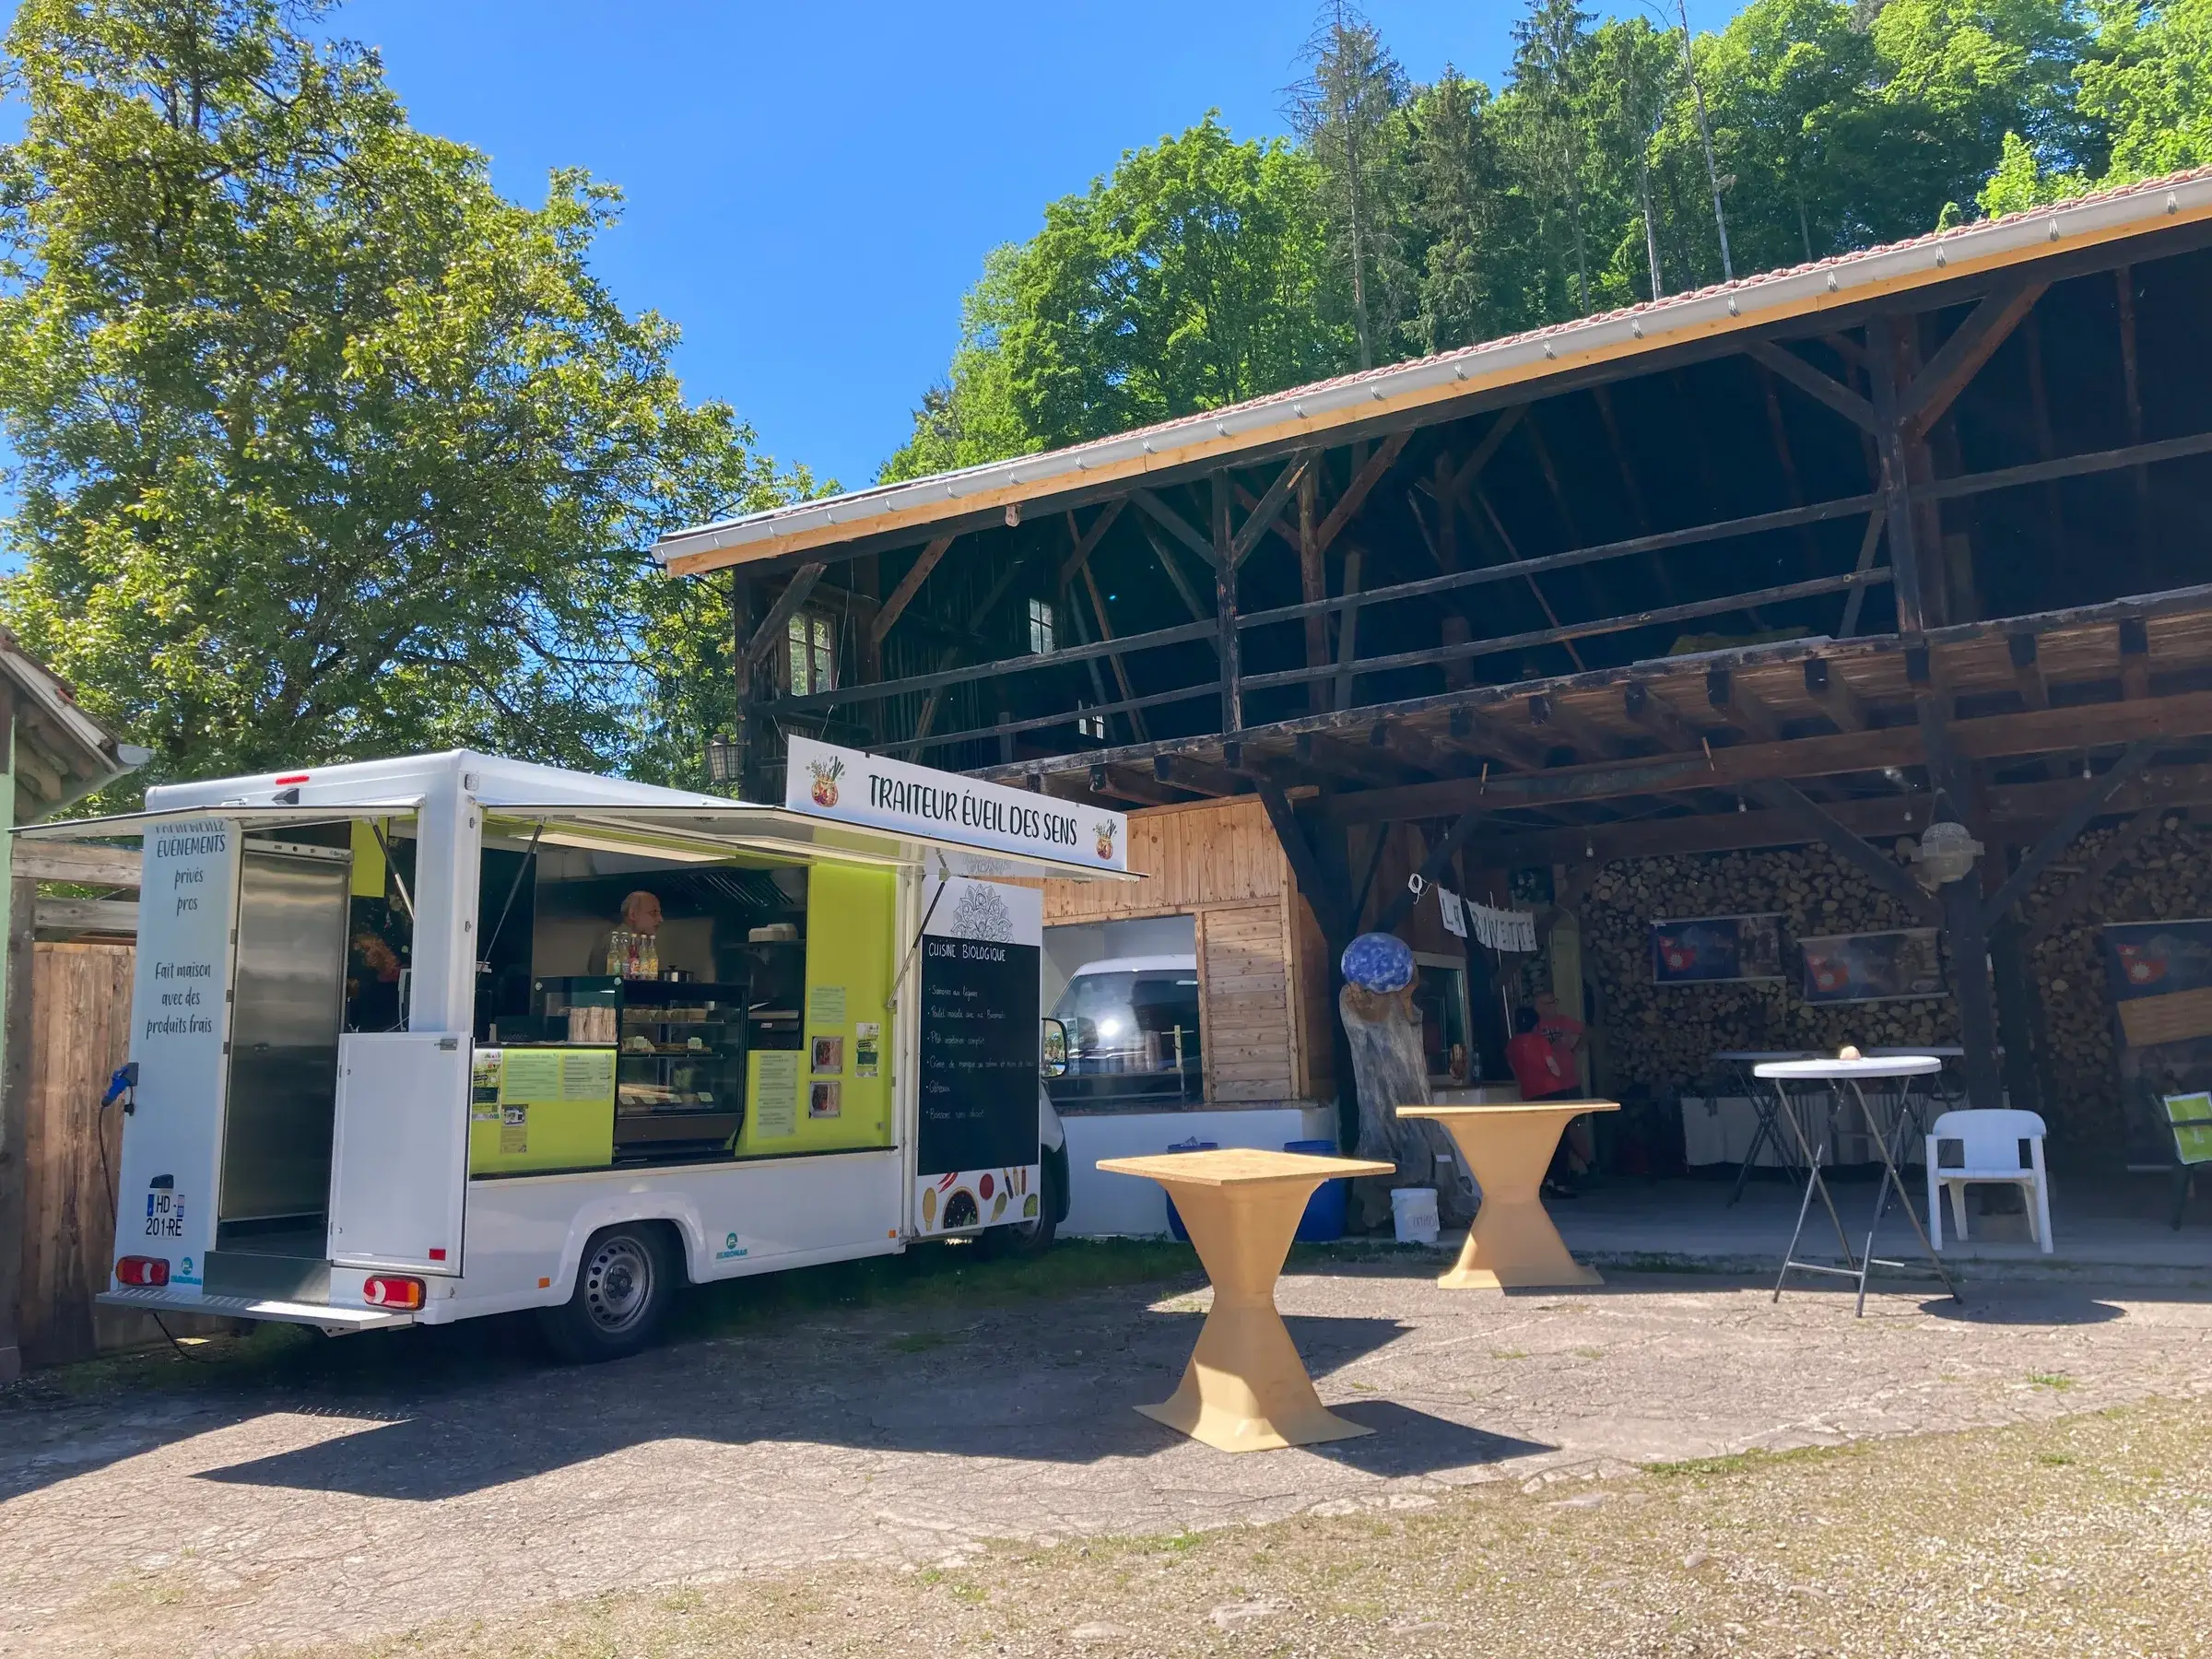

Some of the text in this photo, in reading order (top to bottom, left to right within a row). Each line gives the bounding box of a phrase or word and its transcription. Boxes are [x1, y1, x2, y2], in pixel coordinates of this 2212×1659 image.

[868, 774, 1077, 846] TRAITEUR ÉVEIL DES SENS
[174, 867, 204, 890] privés
[176, 897, 198, 917] pros
[928, 939, 1006, 962] CUISINE BIOLOGIQUE
[155, 961, 211, 980] Fait maison
[161, 986, 201, 1006] avec des
[146, 1014, 213, 1040] produits frais
[156, 1195, 171, 1213] HD
[145, 1217, 183, 1237] 201-RE
